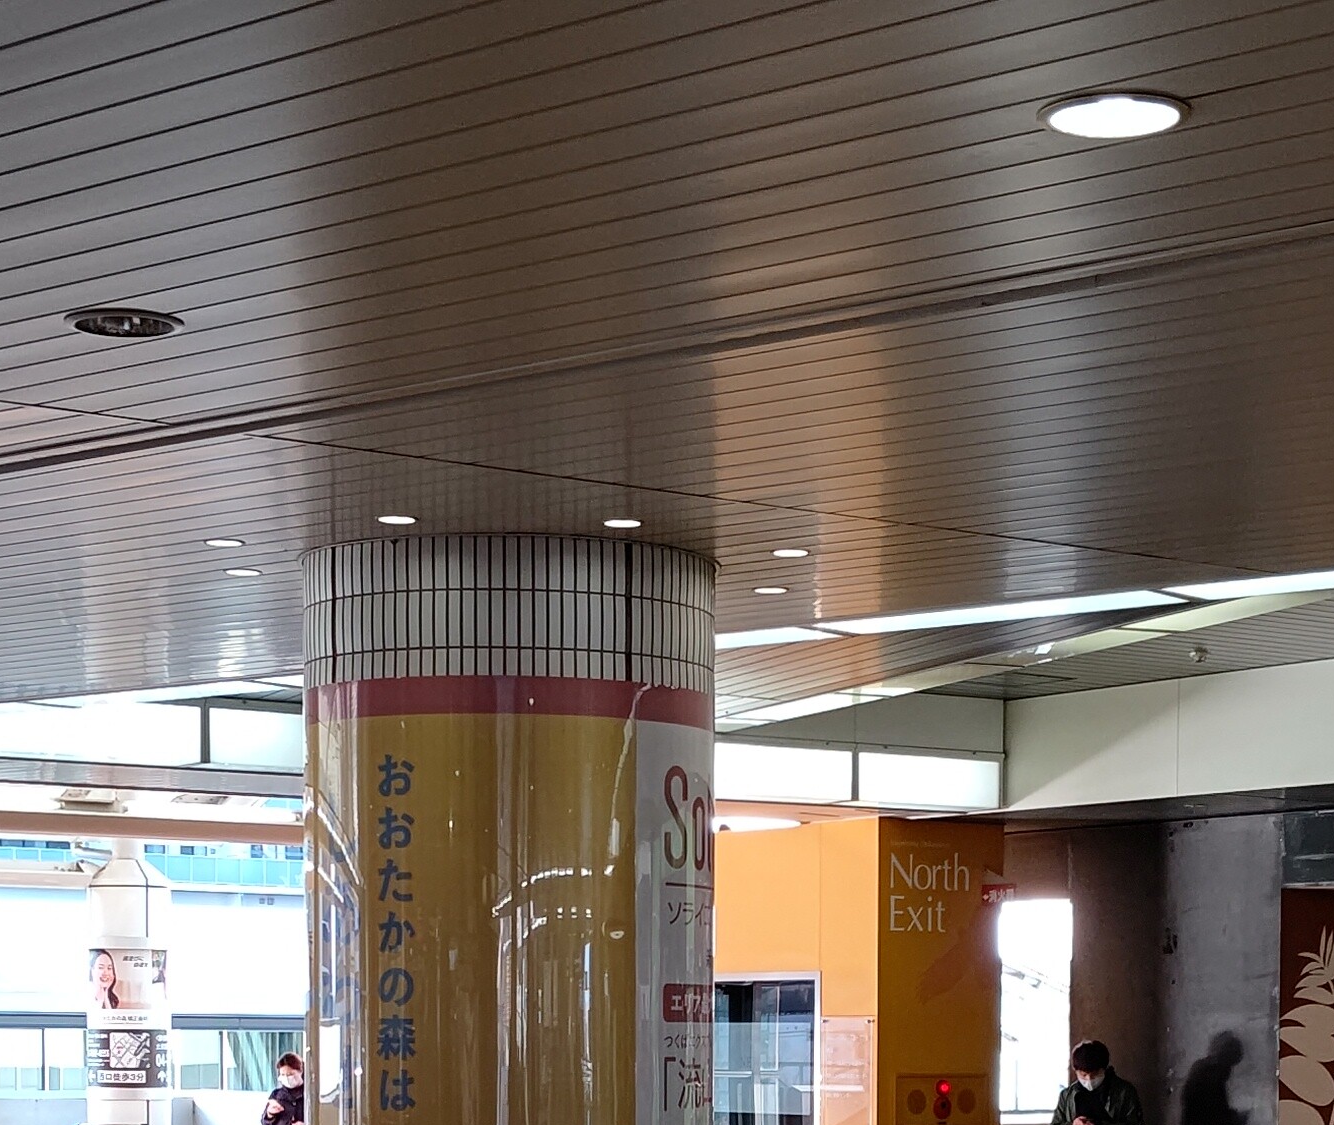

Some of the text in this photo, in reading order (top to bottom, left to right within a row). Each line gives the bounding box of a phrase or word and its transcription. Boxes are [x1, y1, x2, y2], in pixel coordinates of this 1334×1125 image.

[890, 852, 969, 891] North
[377, 754, 416, 1112] おおたかの森は
[890, 895, 945, 933] Exit
